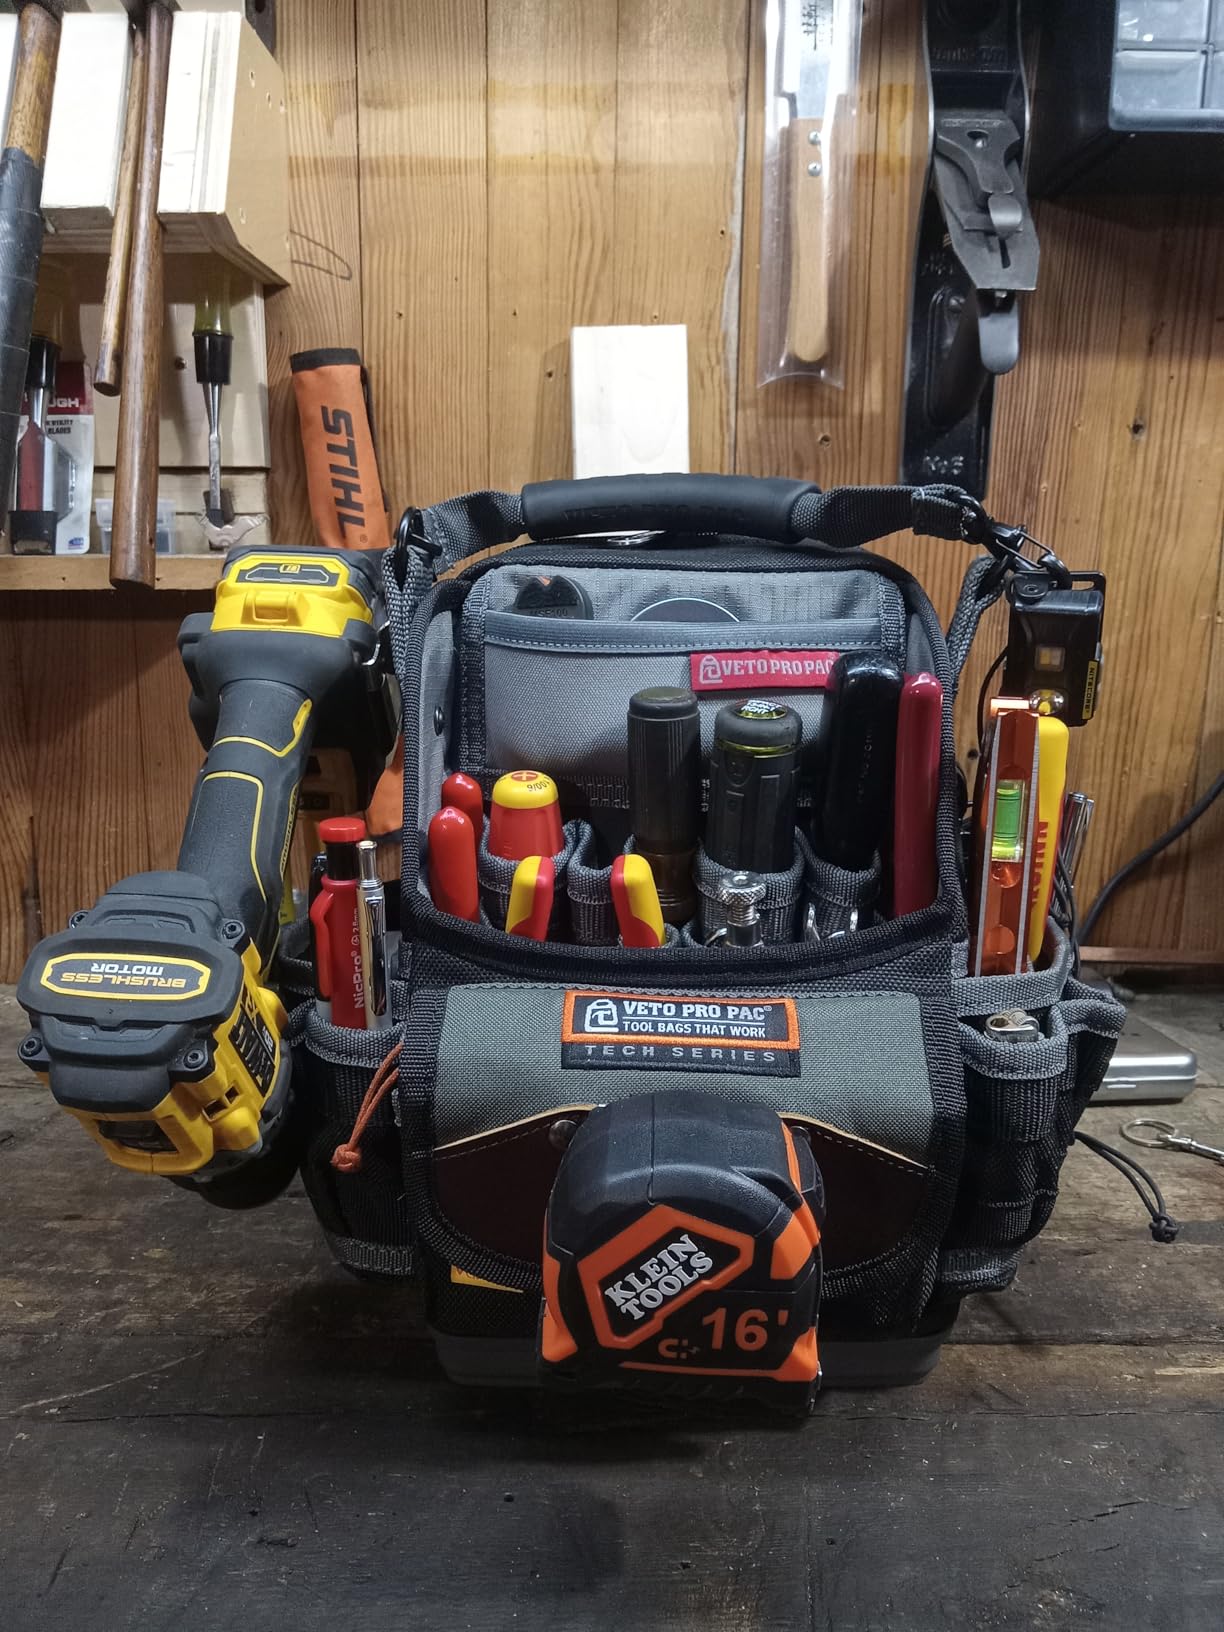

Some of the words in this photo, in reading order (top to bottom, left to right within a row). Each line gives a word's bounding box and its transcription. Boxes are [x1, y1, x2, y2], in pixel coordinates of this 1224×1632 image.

[720, 658, 768, 676] VETO
[770, 658, 803, 675] PRO
[90, 962, 164, 976] MOTOR
[60, 971, 188, 989] BRUSHLESS
[622, 1000, 676, 1016] VETO
[682, 1003, 722, 1018] PRO
[622, 1020, 655, 1033] TOOL
[657, 1022, 692, 1034] BAGS
[694, 1023, 726, 1036] THAT
[729, 1025, 766, 1038] WORK
[584, 1045, 655, 1057] TECH
[672, 1046, 776, 1063] SERIES
[604, 1233, 699, 1307] KLEIN
[620, 1251, 713, 1320] TOOLS
